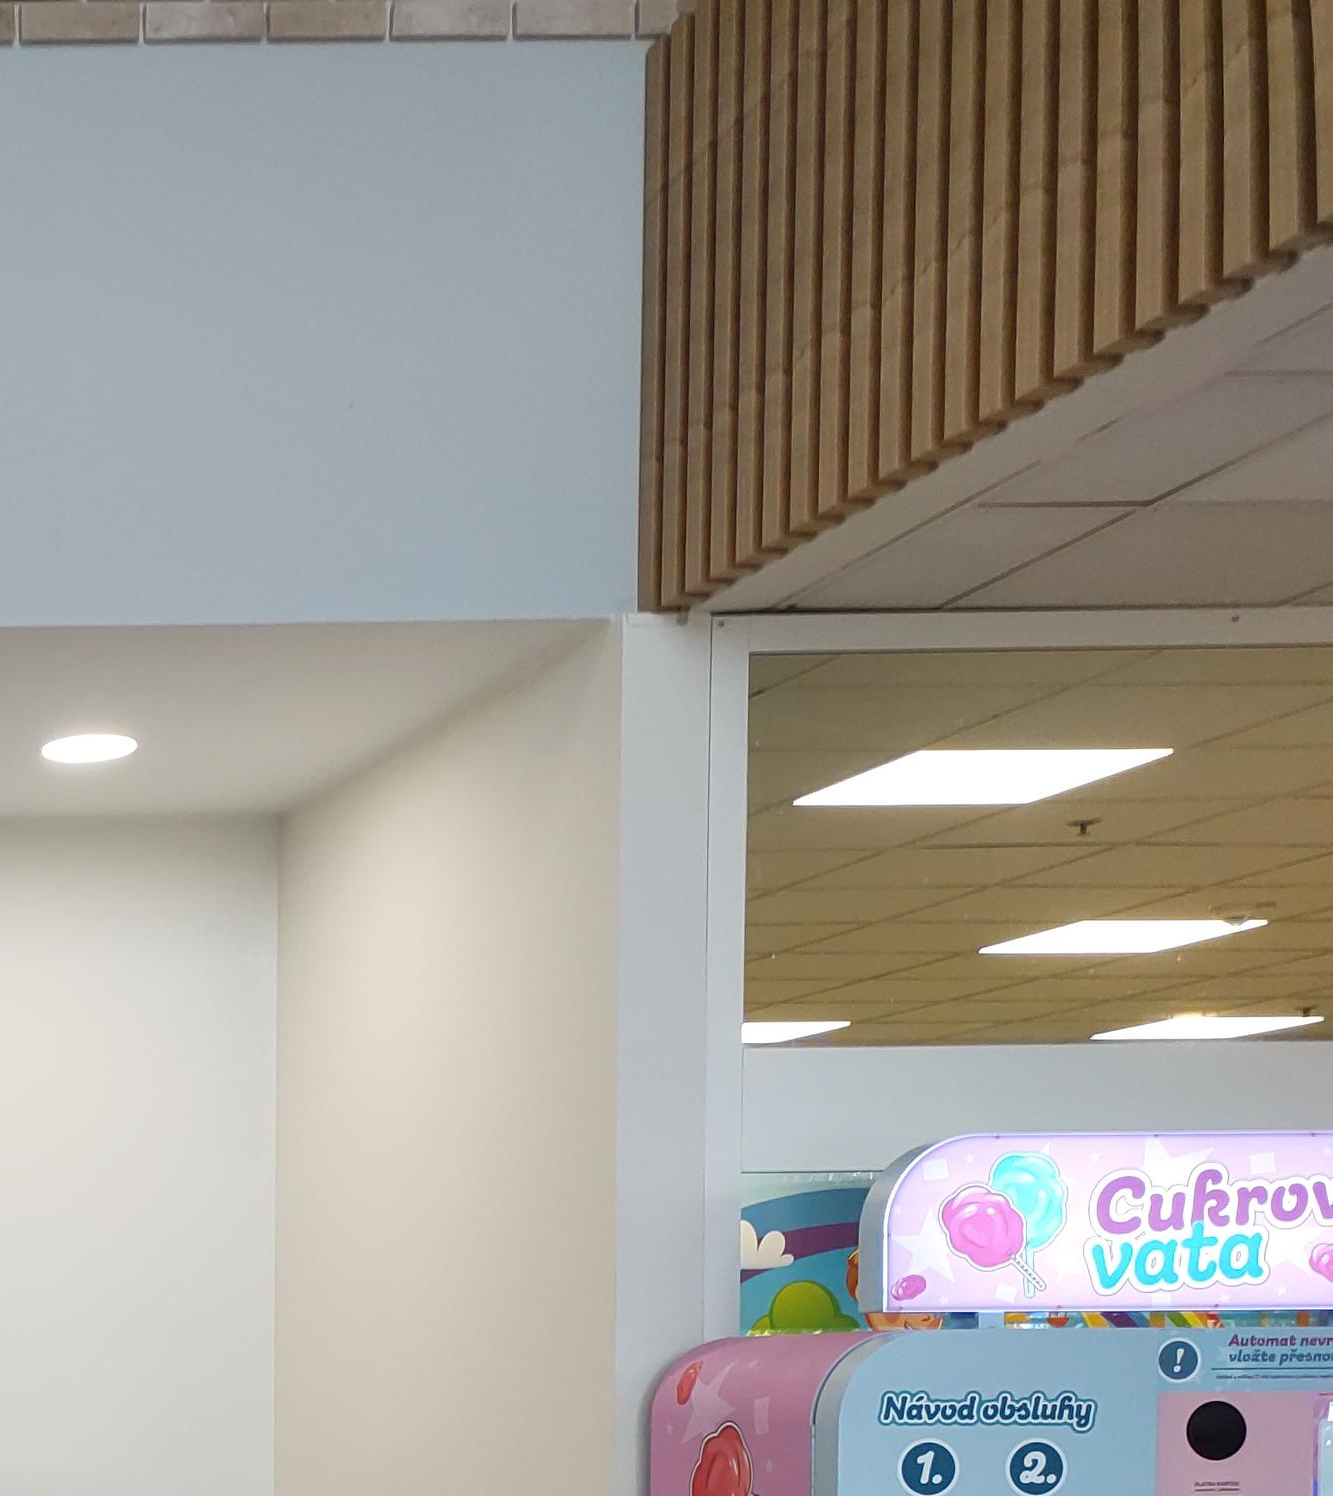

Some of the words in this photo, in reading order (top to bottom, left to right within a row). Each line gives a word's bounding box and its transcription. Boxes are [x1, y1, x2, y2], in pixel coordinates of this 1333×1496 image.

[1091, 1220, 1264, 1290] vata
[1228, 1334, 1297, 1347] Automat
[1229, 1349, 1276, 1362] vložte
[1279, 1349, 1333, 1366] přesno
[883, 1394, 978, 1423] Návod
[982, 1394, 1093, 1430] obsluhy
[916, 1449, 943, 1485] 1.
[1019, 1449, 1057, 1485] 2.
